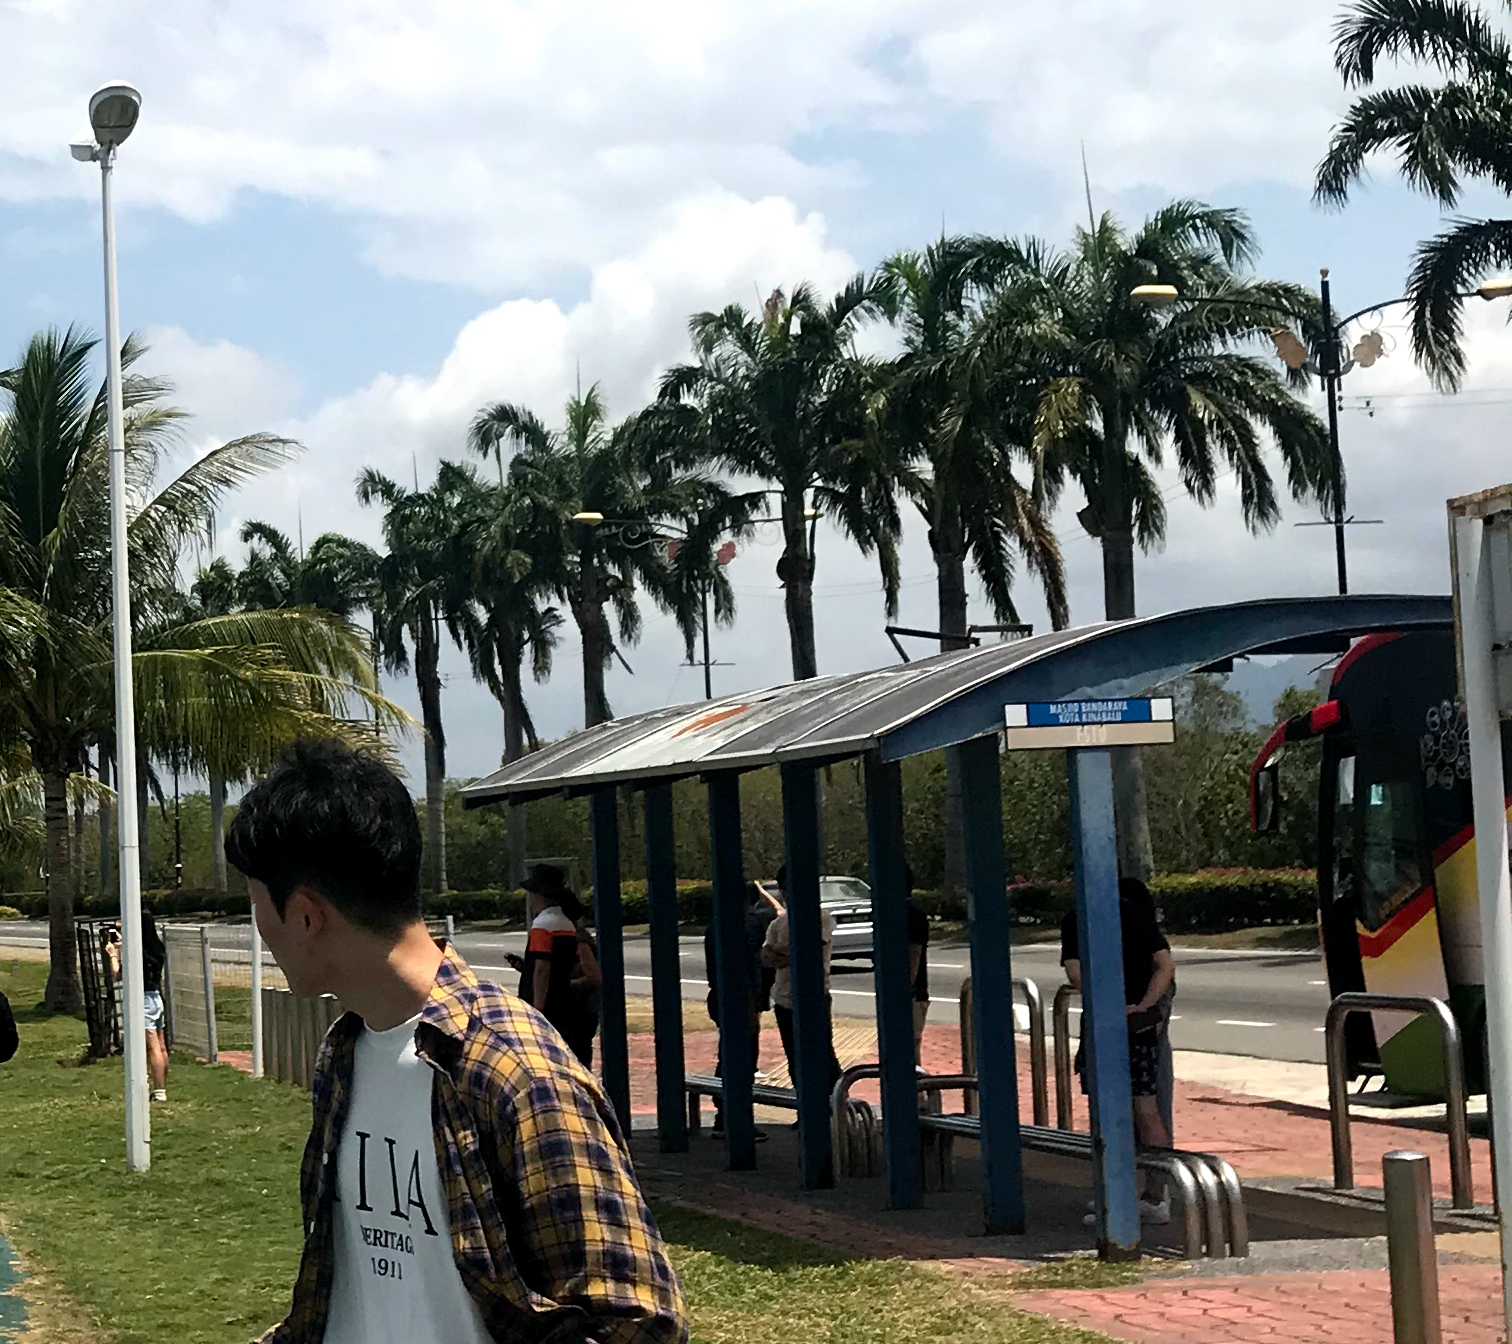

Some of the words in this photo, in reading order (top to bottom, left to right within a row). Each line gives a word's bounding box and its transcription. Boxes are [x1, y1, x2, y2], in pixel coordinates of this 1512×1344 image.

[1058, 712, 1080, 723] KOTA
[1082, 711, 1122, 722] KINABALU
[360, 1224, 415, 1255] ERITAG
[371, 1257, 403, 1280] 1911
